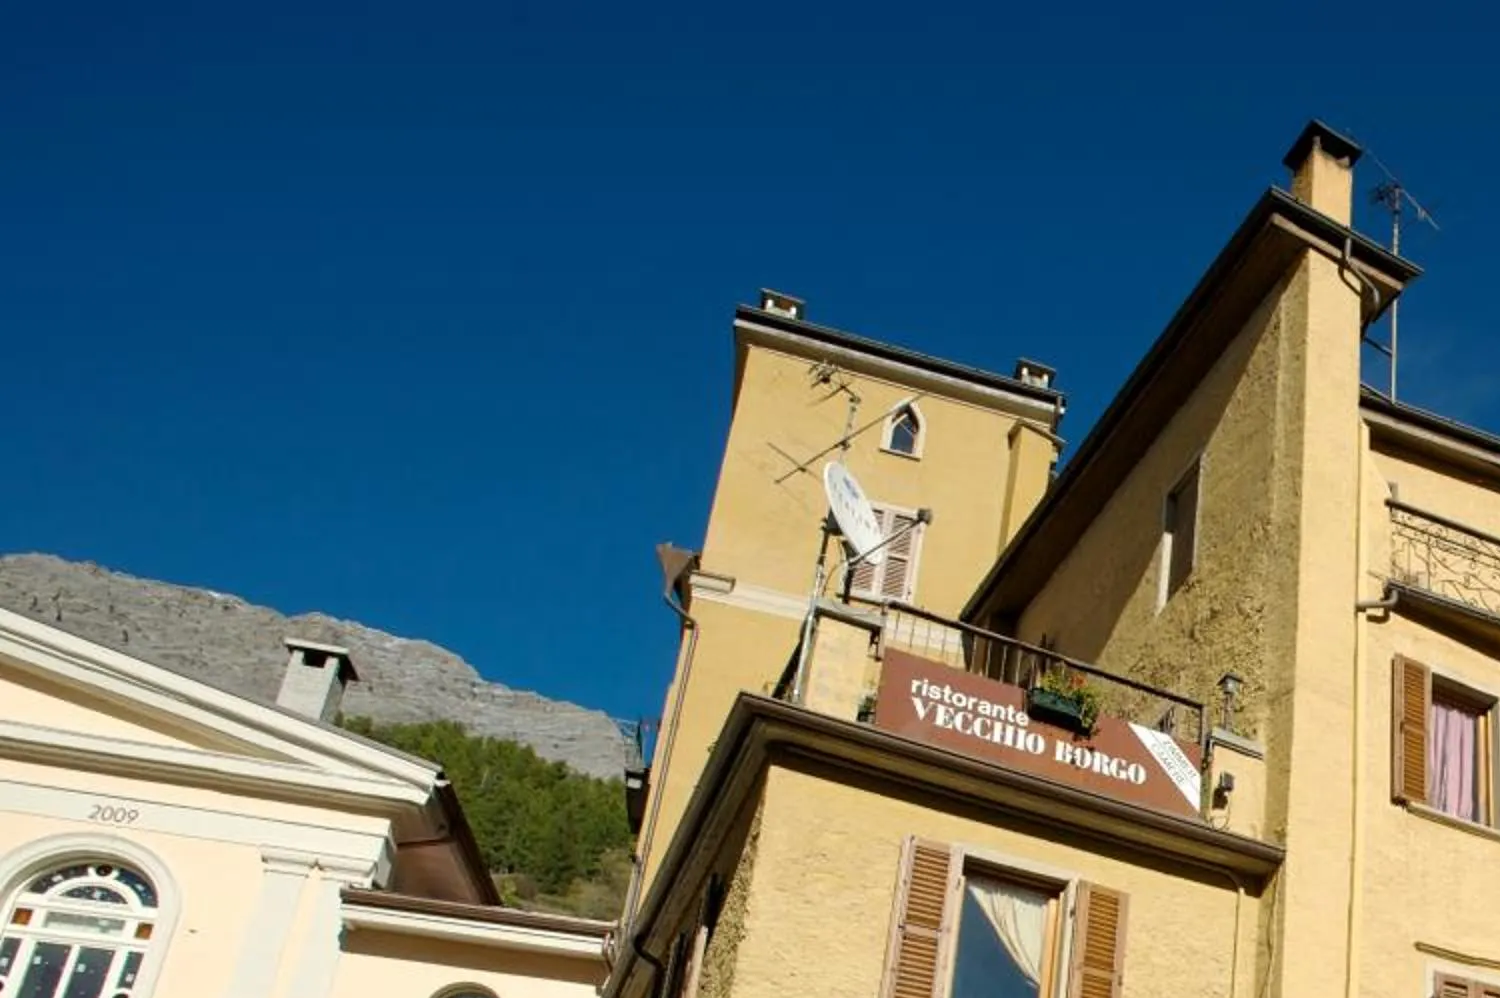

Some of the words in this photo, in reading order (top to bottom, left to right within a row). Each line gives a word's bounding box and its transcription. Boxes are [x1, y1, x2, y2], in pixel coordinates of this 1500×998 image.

[911, 678, 1029, 727] ristorante
[911, 697, 1045, 755] VECCHIO
[1055, 739, 1146, 785] BORGO
[88, 804, 139, 823] 2009
